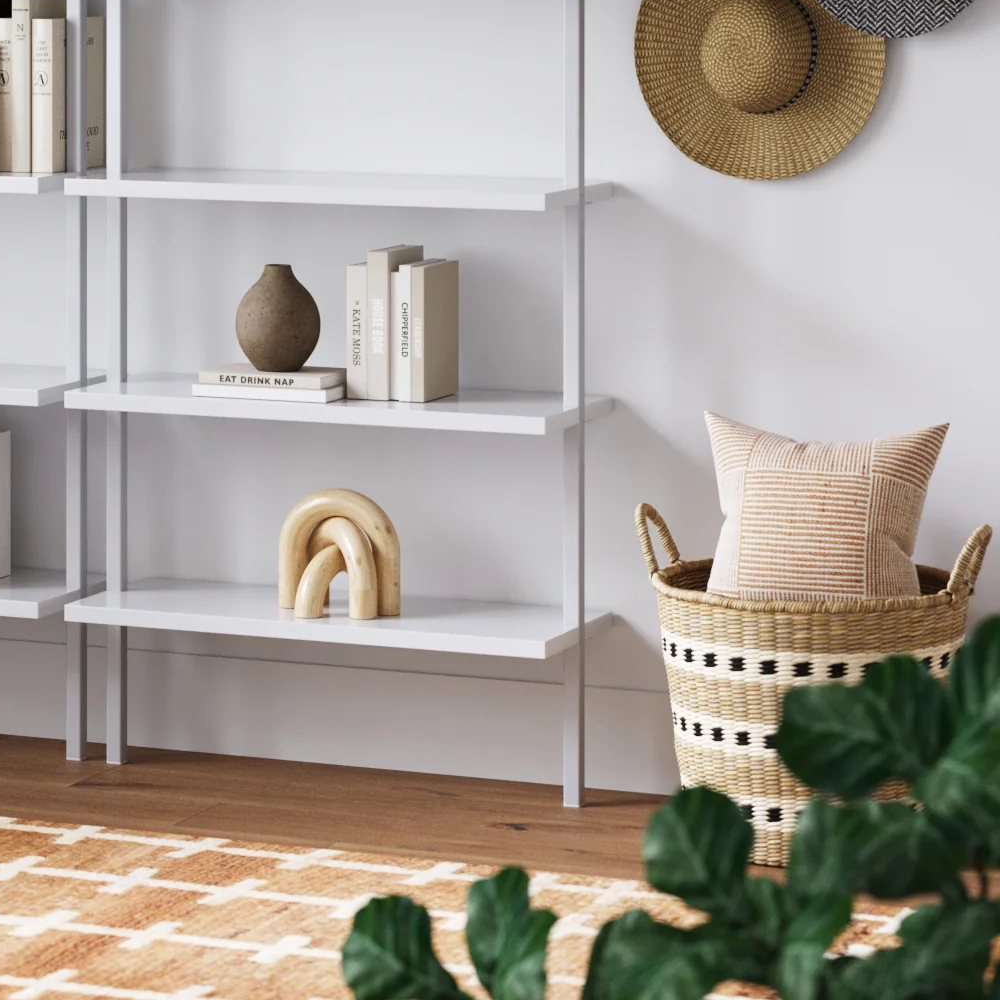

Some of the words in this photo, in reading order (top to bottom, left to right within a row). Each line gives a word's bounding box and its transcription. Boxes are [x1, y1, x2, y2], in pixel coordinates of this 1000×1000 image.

[17, 24, 24, 32] N
[352, 309, 361, 335] KATE
[372, 299, 384, 328] HOUSE
[352, 338, 361, 366] MOSS
[372, 330, 384, 355] BOOK
[219, 374, 237, 383] EAT
[240, 376, 270, 385] DRINK
[274, 378, 294, 386] NAP
